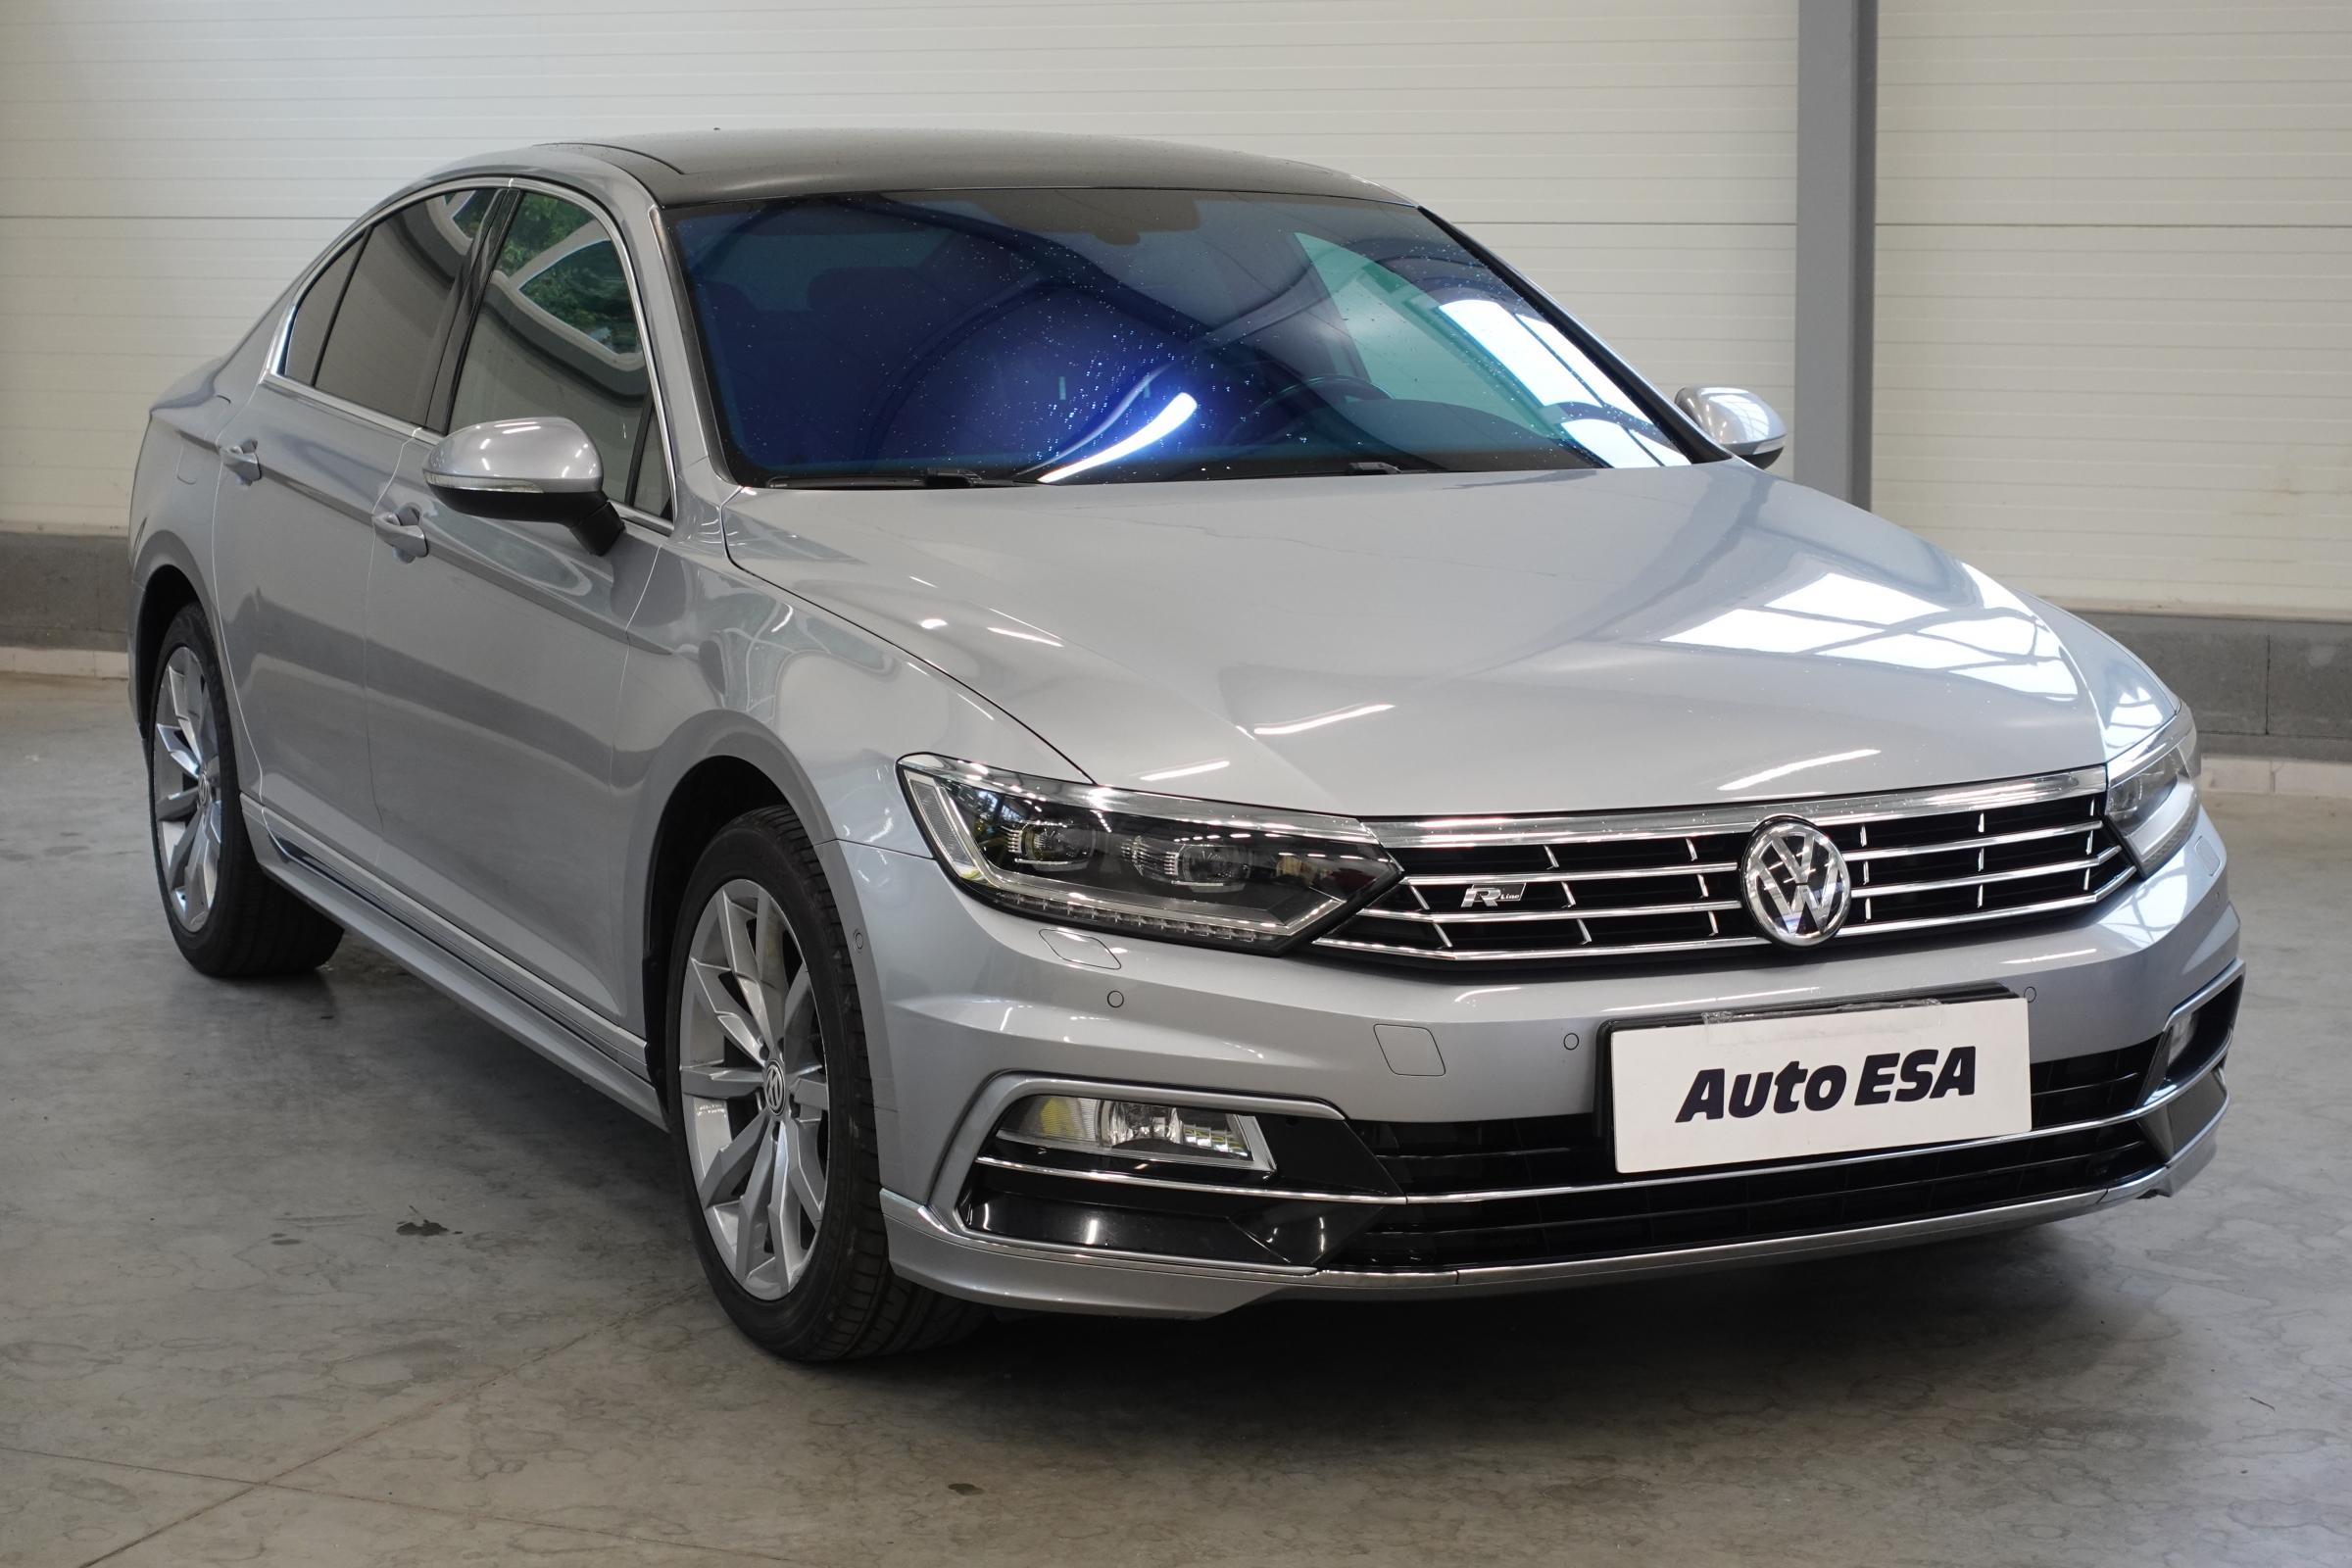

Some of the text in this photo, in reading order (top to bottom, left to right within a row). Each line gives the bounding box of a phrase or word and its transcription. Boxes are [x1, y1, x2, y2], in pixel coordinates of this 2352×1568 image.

[1460, 887, 1501, 907] R
[1749, 824, 1848, 939] VW
[1675, 1046, 1977, 1123] Auto ESA
